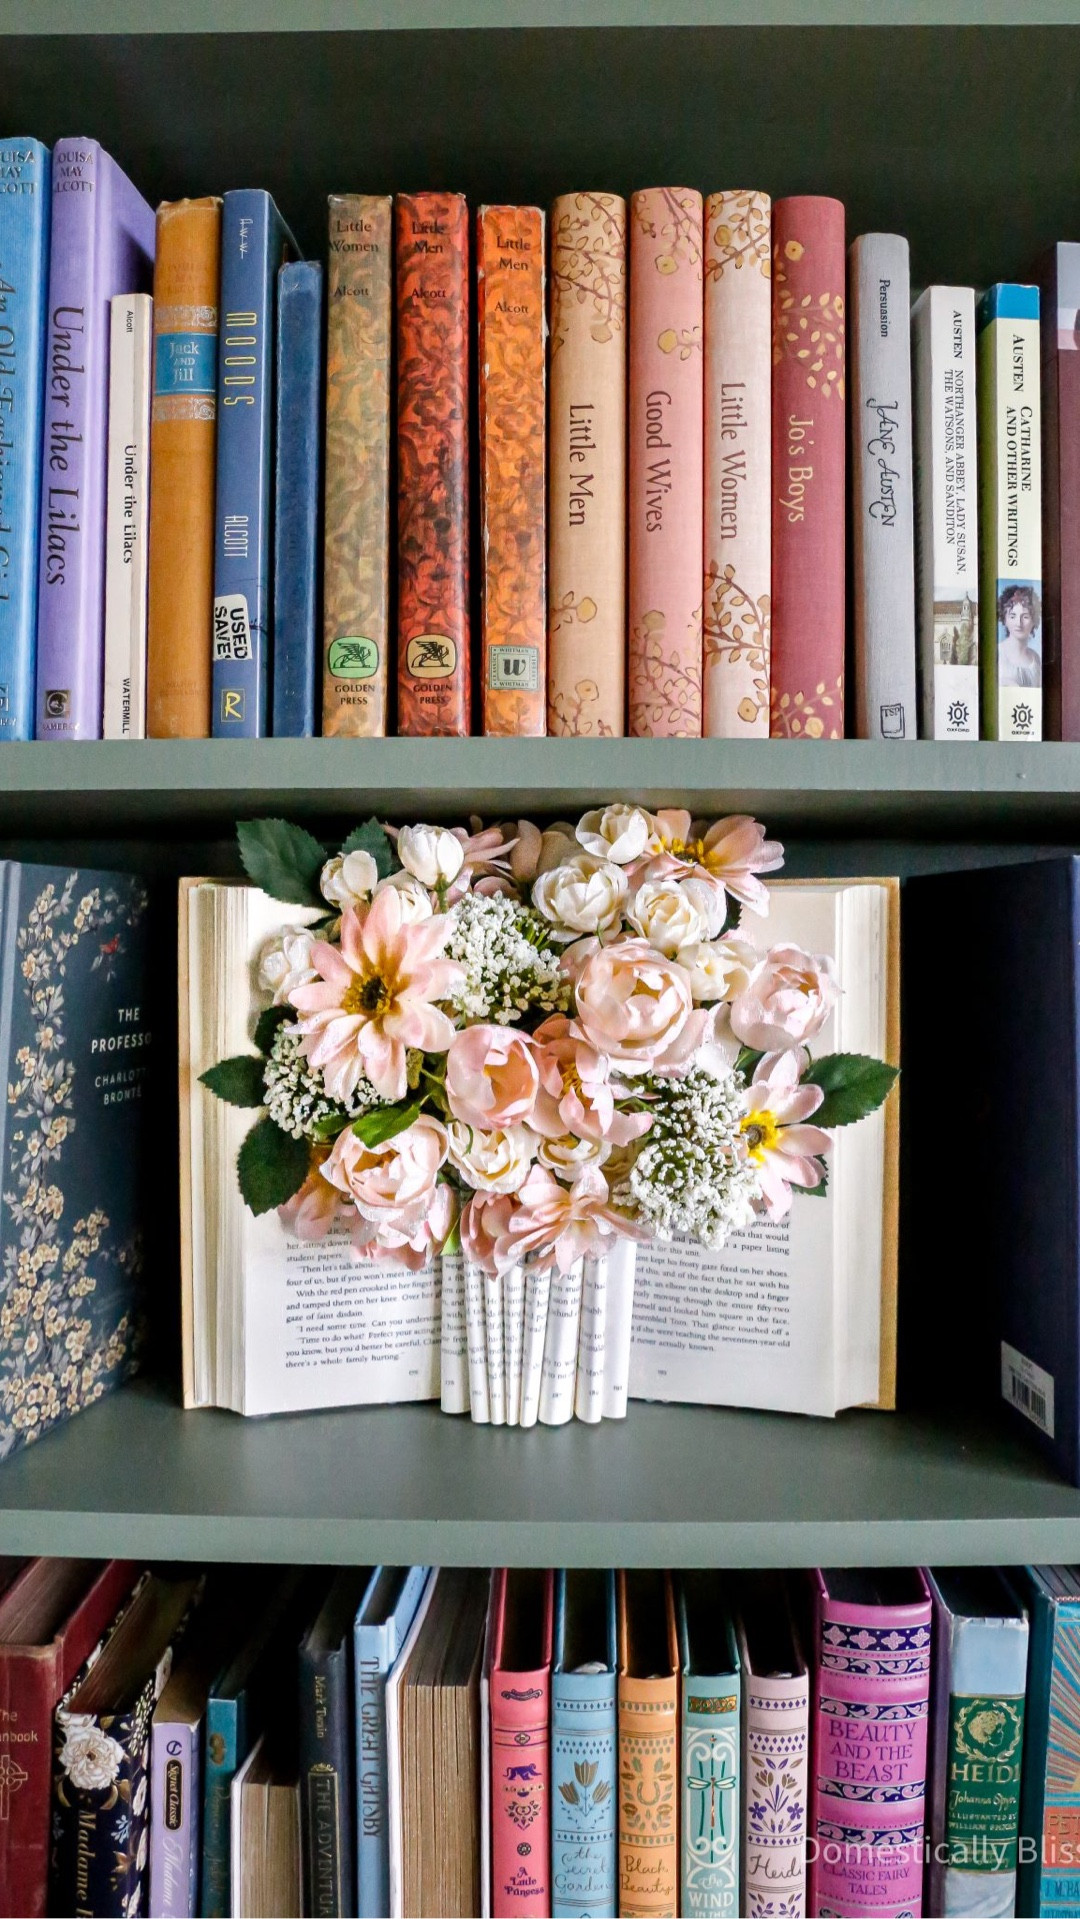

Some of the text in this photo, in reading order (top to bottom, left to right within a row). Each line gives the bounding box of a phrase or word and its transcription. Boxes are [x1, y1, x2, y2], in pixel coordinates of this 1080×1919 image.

[0, 151, 35, 163] UISA
[61, 166, 83, 177] MAY
[54, 180, 93, 192] LCOTT
[336, 220, 371, 233] Little
[412, 222, 445, 235] Little
[328, 240, 379, 253] Women
[414, 242, 443, 254] Men
[496, 238, 531, 251] Little
[499, 259, 529, 270] Men
[333, 286, 369, 297] Alcott
[411, 287, 446, 299] Alcott
[494, 302, 529, 314] Alcott
[879, 279, 890, 337] Persuasion
[125, 310, 133, 333] Alcott
[953, 310, 962, 358] AUSTEN
[170, 341, 199, 358] Jack
[174, 358, 195, 366] AND
[224, 312, 257, 405] MOODS
[1013, 334, 1025, 392] AUSTEN
[173, 368, 193, 384] Jill
[46, 306, 84, 585] Under the Lilacs
[1020, 406, 1032, 491] CATHARINE
[646, 390, 672, 533] Good Wives
[721, 382, 747, 540] Little Women
[866, 398, 900, 528] JANE AUSTEN
[944, 369, 955, 544] THE WATSONS, AND SANDITON
[569, 403, 596, 527] Little Men
[779, 414, 814, 523] Jo's Boys
[955, 370, 966, 575] NORTHANGER ABBEY, LADY SUSAN,
[1006, 406, 1018, 567] AND OTHER WRITINGS
[123, 445, 137, 564] Under the Lilacs
[223, 514, 248, 558] ALCOTT
[230, 607, 248, 659] USED
[334, 684, 375, 693] GOLDEN
[413, 684, 453, 693] GOLDEN
[122, 677, 130, 734] WATERMILL
[340, 697, 368, 705] PRESS
[420, 696, 446, 705] PRESS
[118, 1007, 140, 1023] THE
[748, 1231, 789, 1242] that would
[741, 1244, 789, 1256] paper listing
[752, 1267, 764, 1275] her
[716, 1276, 731, 1284] that
[296, 1289, 315, 1297] With
[330, 1287, 342, 1295] red
[714, 1288, 742, 1299] desktop
[767, 1293, 789, 1302] finger
[286, 1302, 300, 1310] and
[306, 1324, 324, 1332] need
[389, 1320, 402, 1328] you
[286, 1350, 300, 1358] you
[315, 1675, 327, 1738] Mark Twain
[0, 1730, 38, 1742] nbook
[828, 1719, 917, 1743] BEAUTY
[360, 1656, 382, 1837] THE GREAT GATSBY
[831, 1742, 912, 1760] AND THE
[834, 1760, 908, 1782] BEAST
[951, 1762, 1021, 1783] HEIDI
[948, 1789, 991, 1810] Johanna
[948, 1821, 986, 1830] WILLIAM
[76, 1809, 97, 1901] Madame
[316, 1779, 334, 1919] THE ADVENTUR
[516, 1867, 528, 1878] A
[624, 1855, 669, 1874] Black
[748, 1854, 802, 1879] Heidi
[822, 1862, 910, 1880] CLASSIC FAIRY
[510, 1876, 537, 1886] Little
[620, 1873, 674, 1896] Beauty
[848, 1882, 887, 1896] TALES
[504, 1885, 545, 1897] Princess
[688, 1891, 735, 1909] WIND
